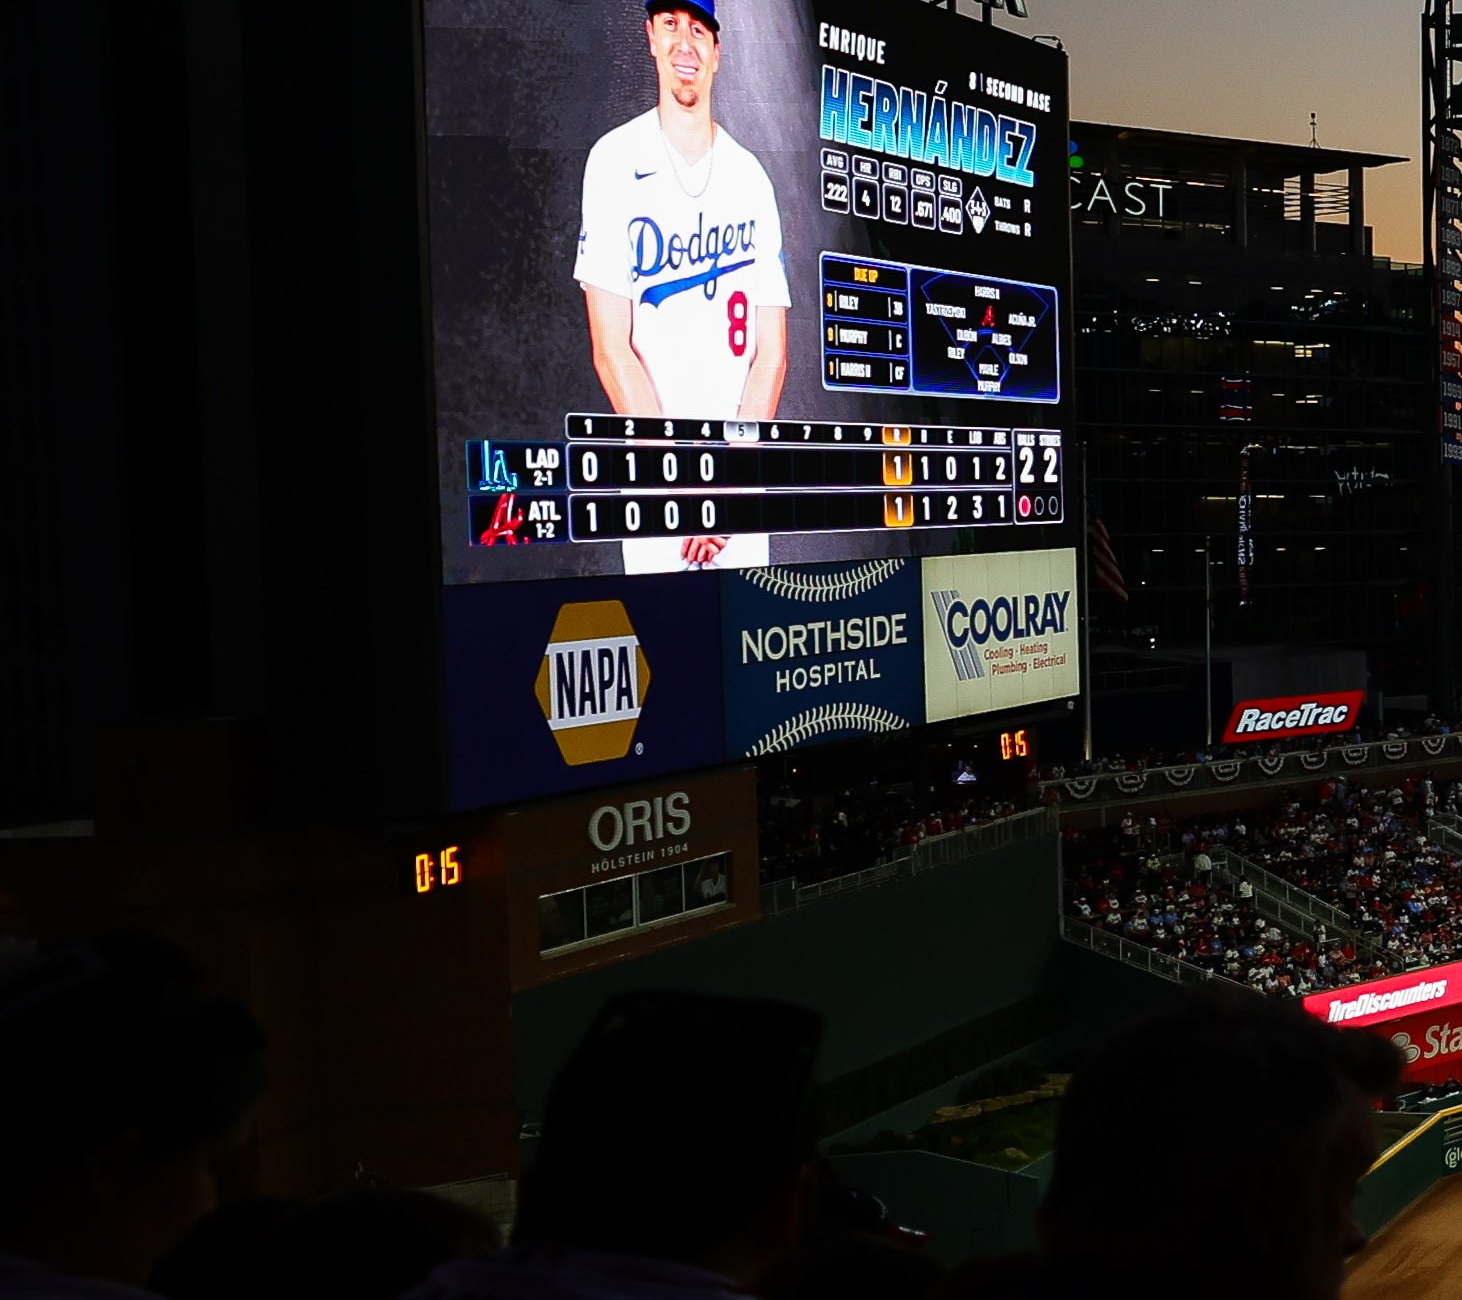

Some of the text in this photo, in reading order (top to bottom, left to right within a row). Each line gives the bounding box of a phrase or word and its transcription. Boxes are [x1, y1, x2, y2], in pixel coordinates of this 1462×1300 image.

[819, 22, 886, 65] ENRIQUE
[986, 76, 1051, 113] SECOND BASE
[820, 64, 1036, 188] HERNÁNDEZ
[826, 154, 958, 193] AVG SLG
[824, 183, 962, 224] .222 4 12 .671 .400
[726, 290, 748, 358] 8
[584, 418, 872, 441] 1 2 3 4 5 6 7 8 9
[525, 448, 559, 469] LAD
[582, 452, 1006, 482] 0 1 0 0 1 0 2
[1019, 447, 1058, 483] 2 2
[534, 471, 553, 486] 2-1
[528, 501, 561, 522] ATL
[586, 495, 983, 532] 1 0 0 0 2 3
[536, 523, 555, 538] 1-2
[948, 590, 1071, 649] COOLRAY
[742, 613, 908, 664] NORTHSIDE
[984, 642, 1048, 662] Cooling Heating
[556, 646, 634, 719] NAPA
[776, 658, 881, 693] HOSPITAL
[992, 653, 1066, 676] Plumbing Electrical
[1235, 702, 1349, 735] RaceTrac
[1001, 730, 1027, 760] 0:15
[588, 792, 691, 851] ORIS
[661, 843, 689, 858] 1904
[415, 846, 461, 893] 0:15
[1328, 979, 1447, 1022] TireDiscounters
